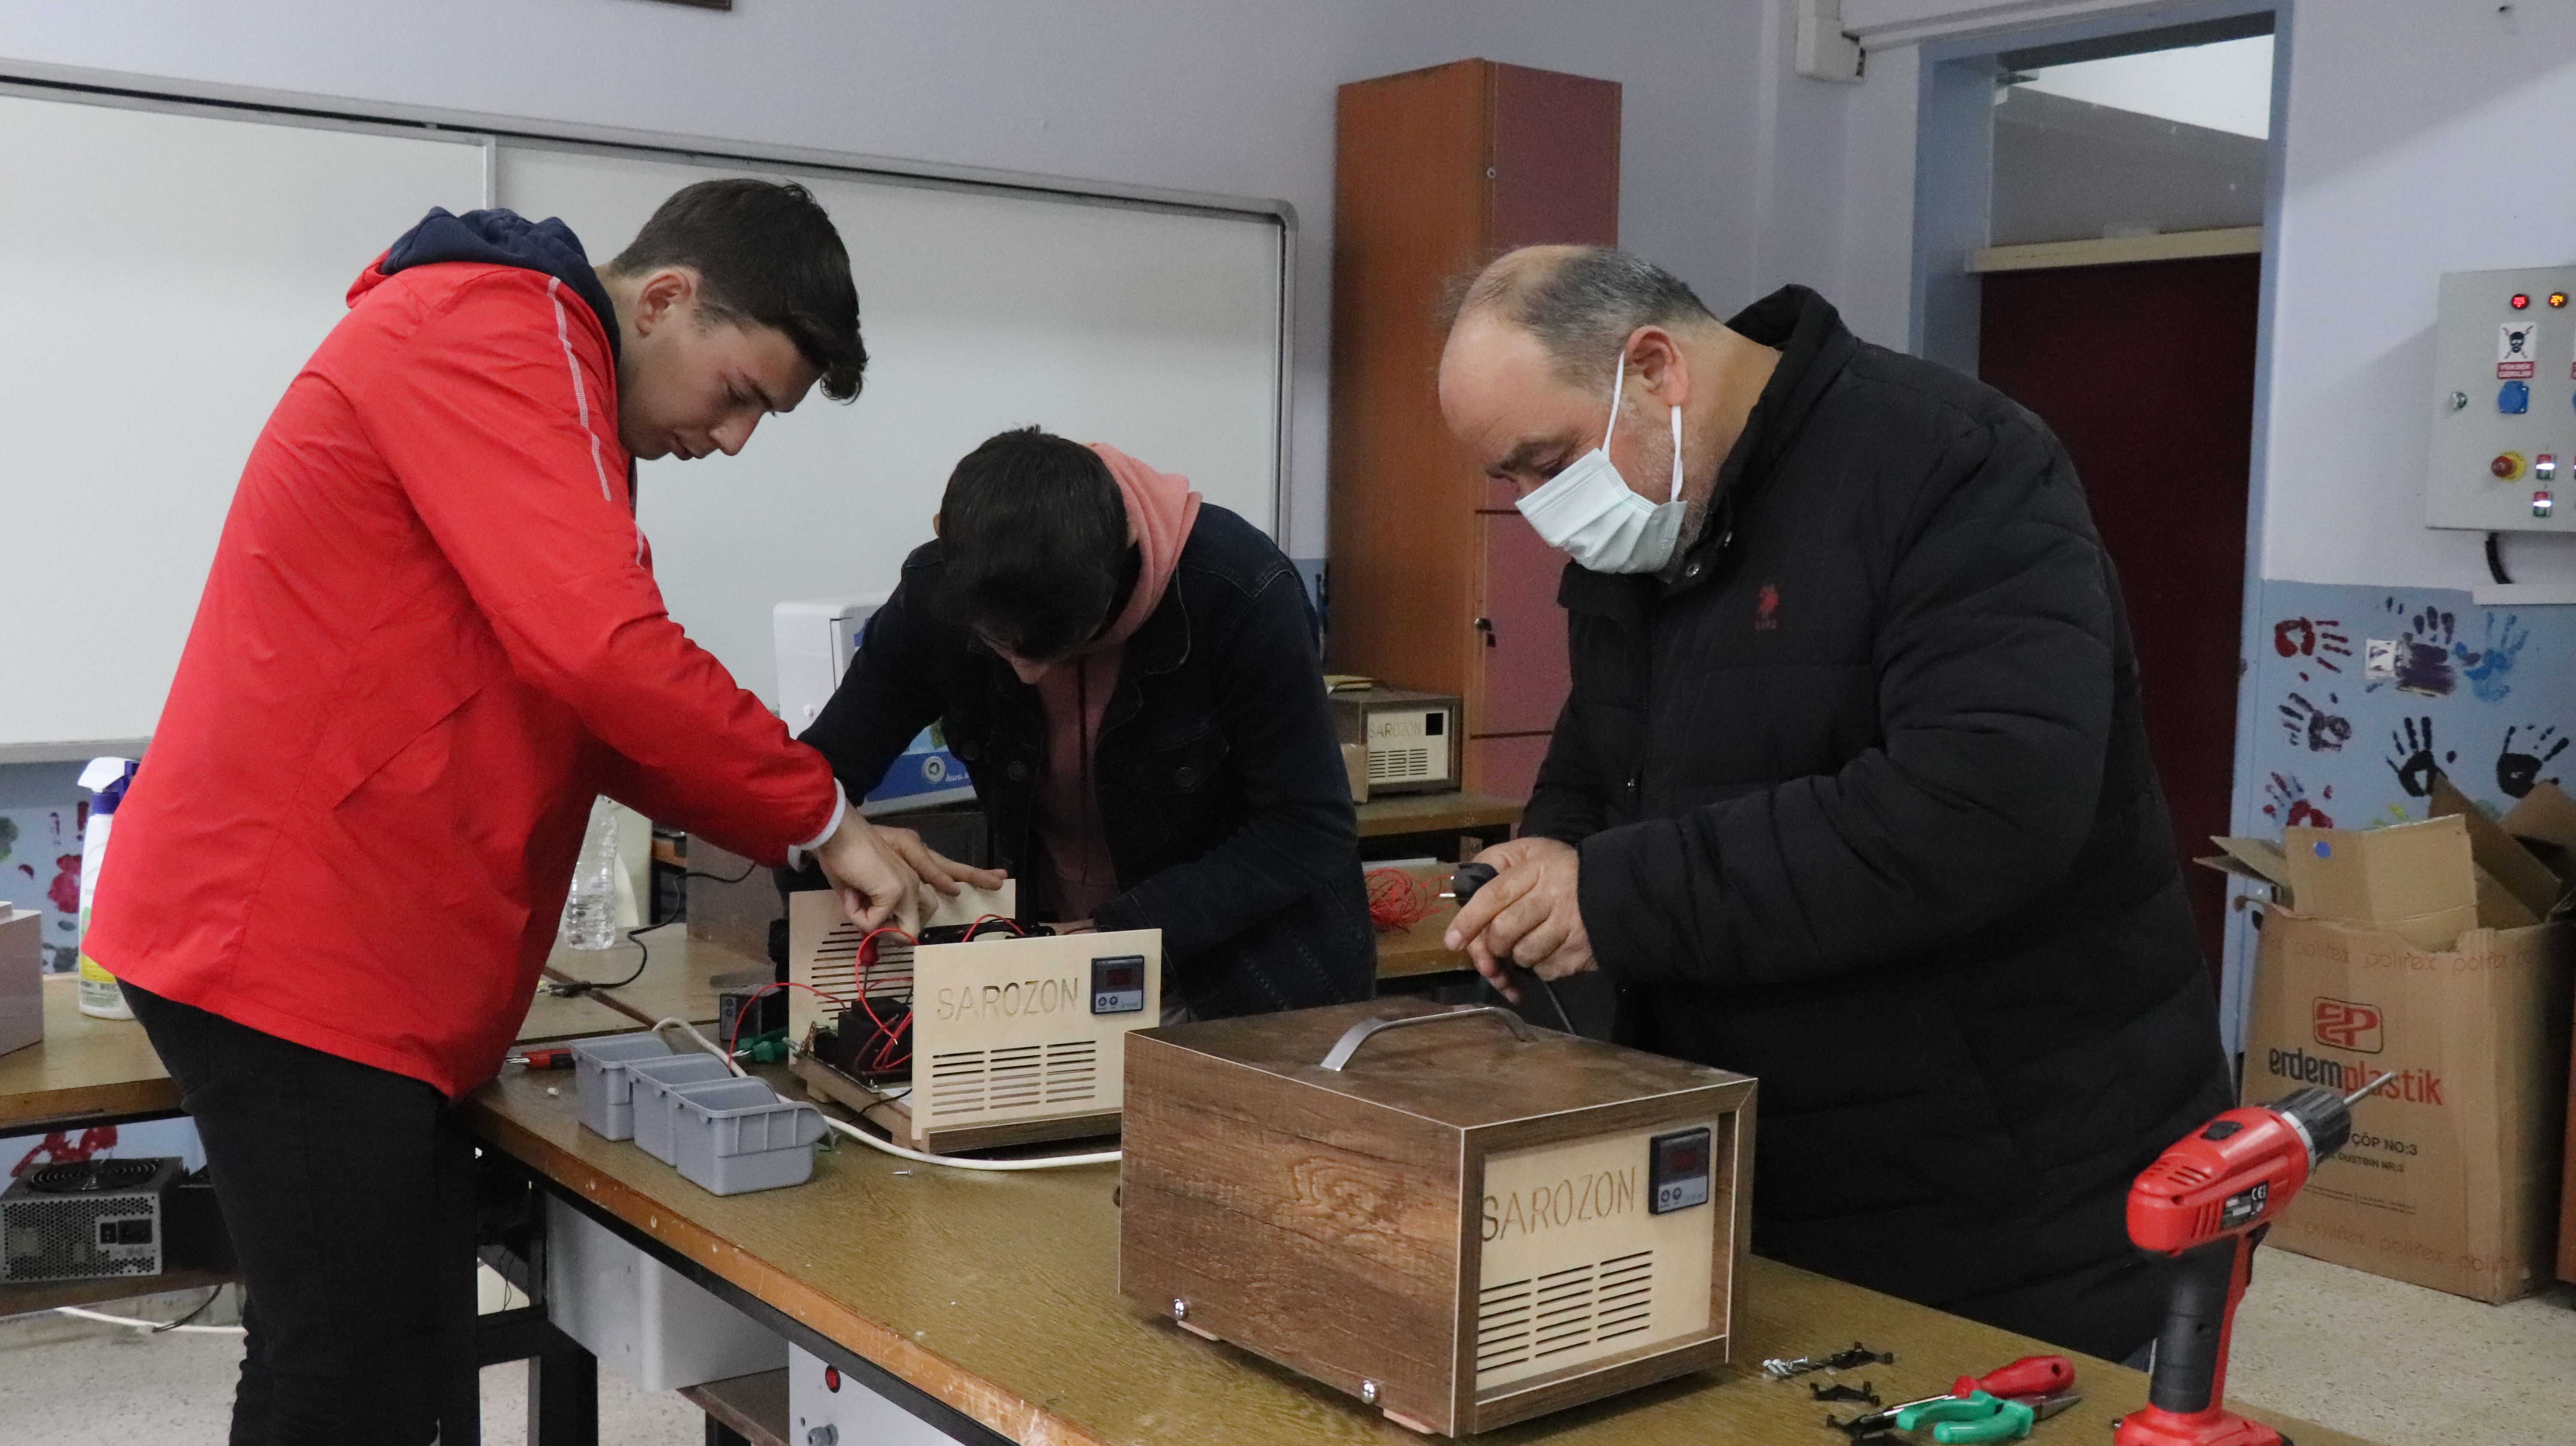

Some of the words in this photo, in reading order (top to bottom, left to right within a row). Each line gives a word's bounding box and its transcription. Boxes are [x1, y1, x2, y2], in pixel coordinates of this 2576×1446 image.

[1368, 721, 1422, 738] SAROZON
[936, 978, 1078, 1021] SAROZON
[2269, 1047, 2443, 1106] erdemplastik
[2339, 1153, 2379, 1168] DUSTBIN
[2351, 1132, 2380, 1148] ÇÖP
[2384, 1139, 2418, 1156] NO:3
[1482, 1166, 1635, 1242] SAROZON
